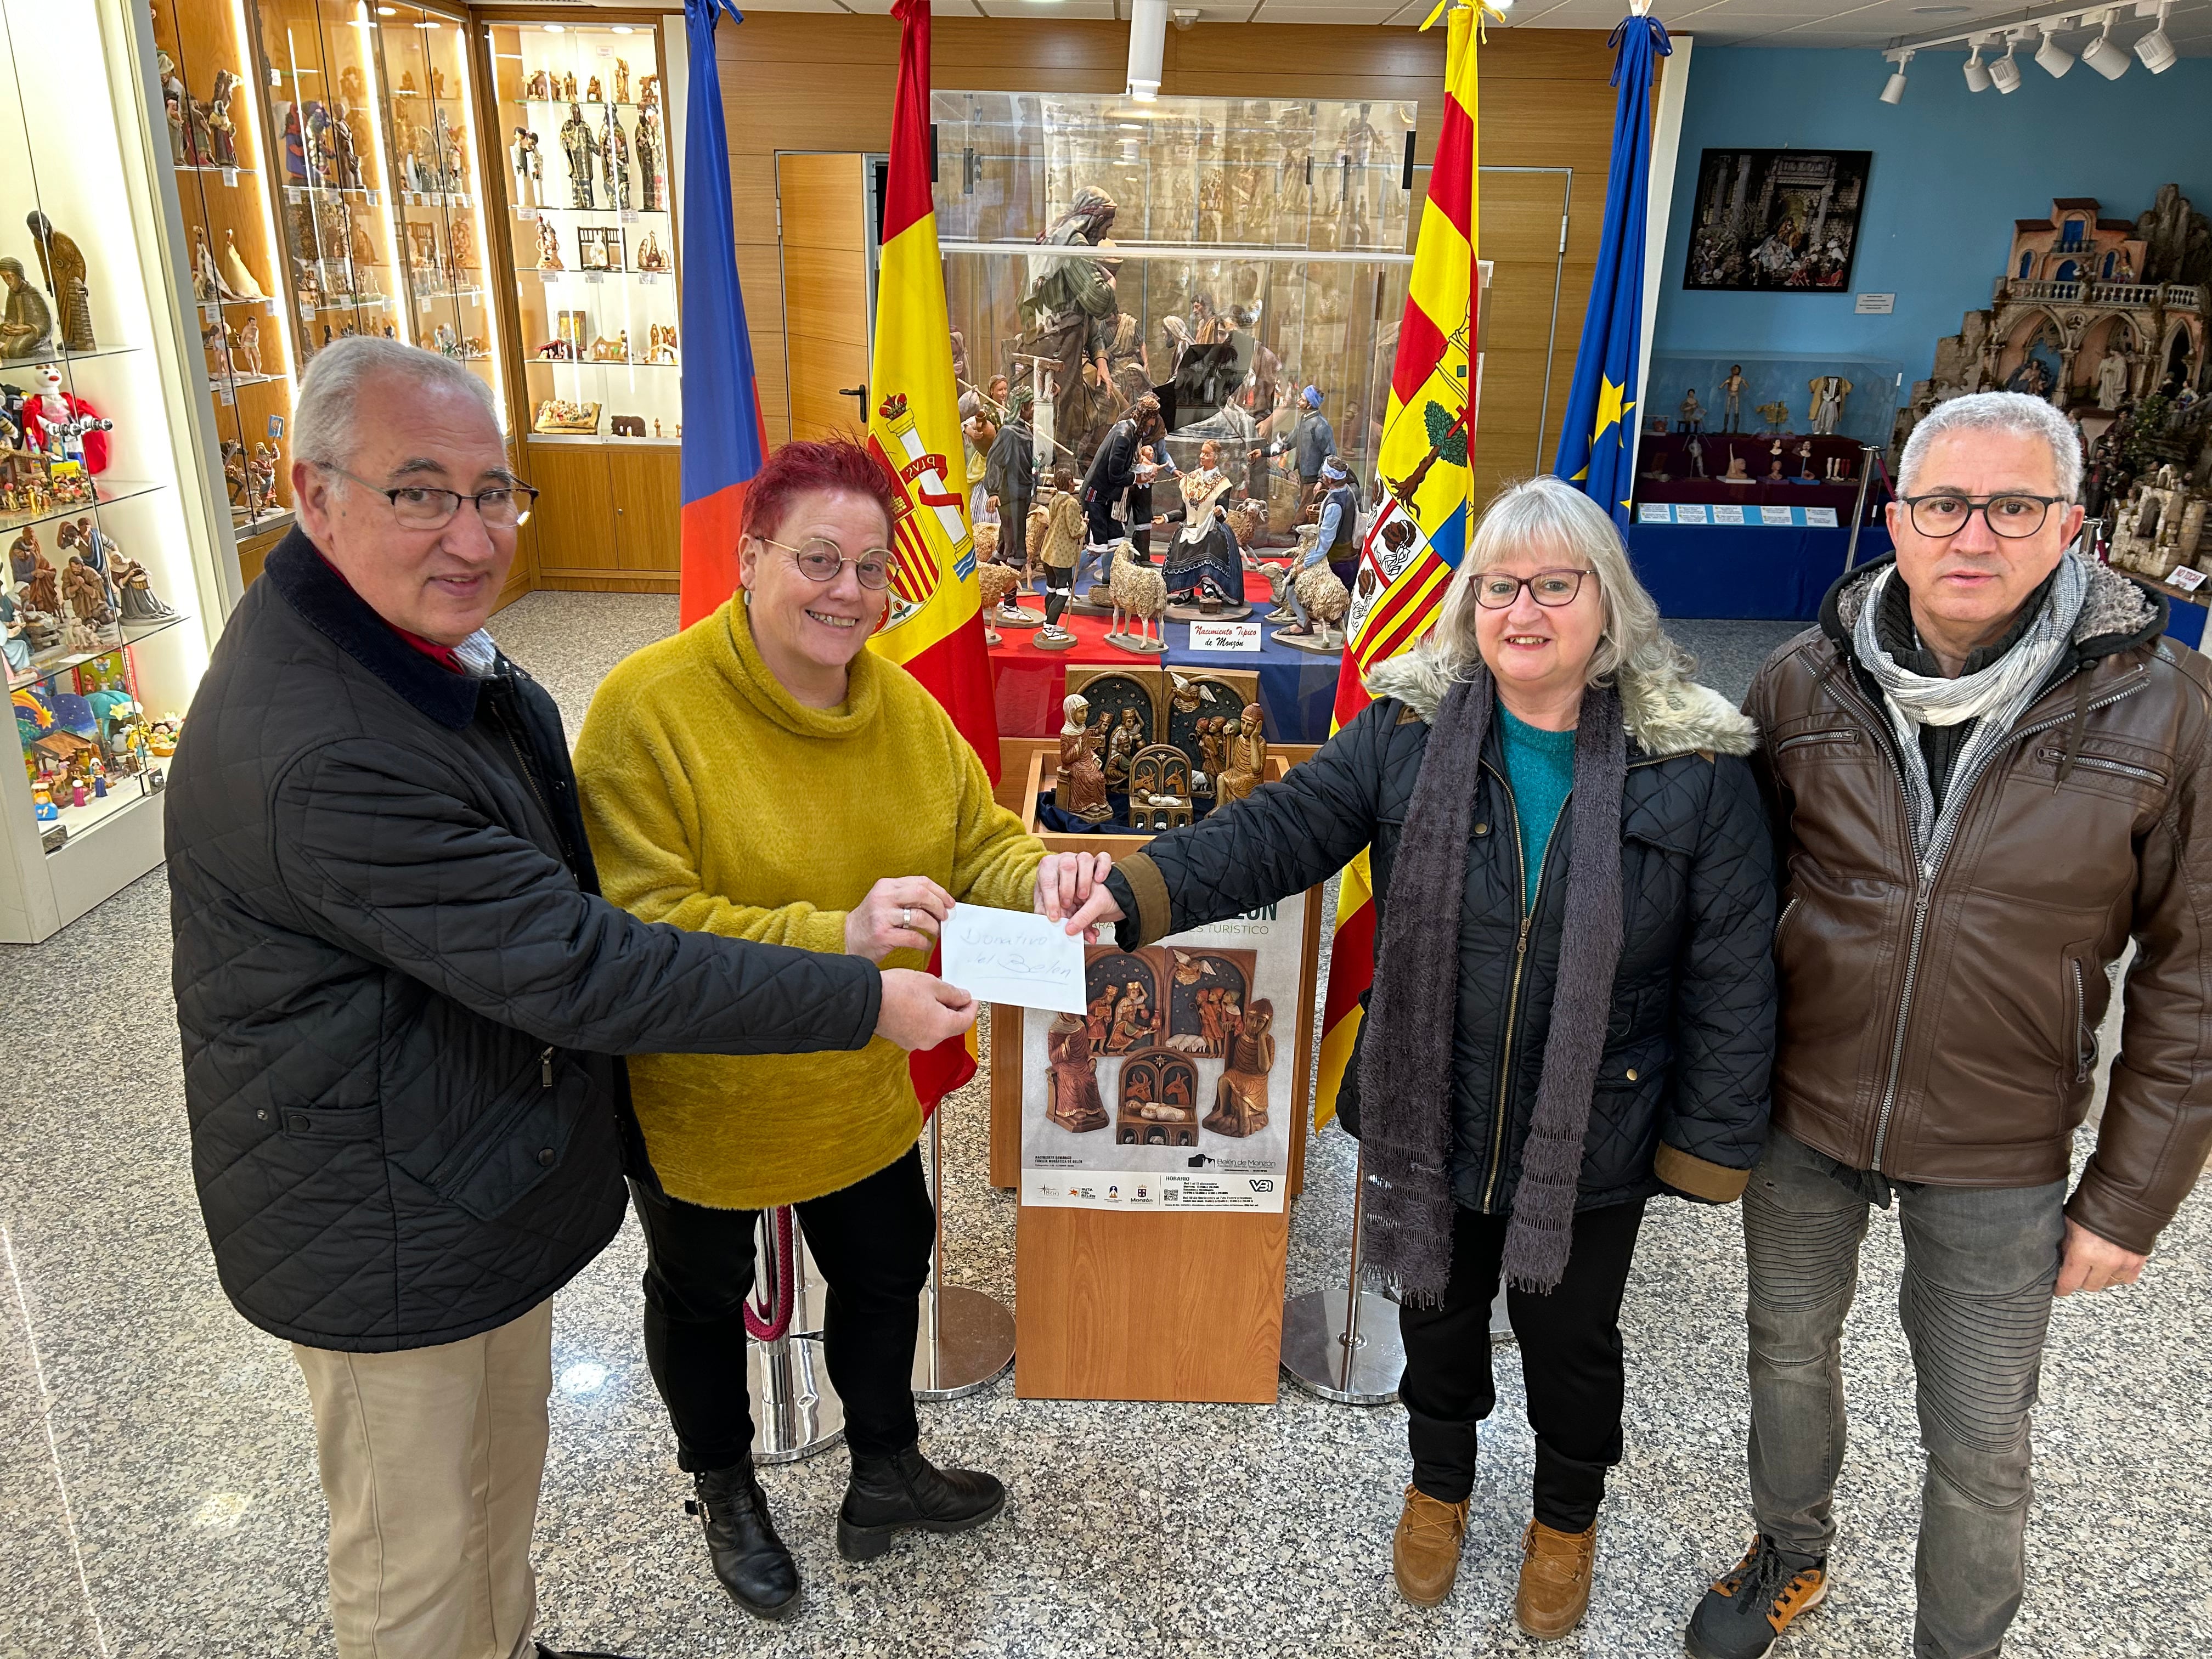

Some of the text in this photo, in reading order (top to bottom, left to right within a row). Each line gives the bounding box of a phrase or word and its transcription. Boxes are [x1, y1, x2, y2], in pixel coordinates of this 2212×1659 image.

[1194, 625, 1233, 636] Nacimiento
[1205, 637, 1244, 649] de Monzón
[1207, 922, 1269, 935] TURÍSTICO
[1217, 1158, 1237, 1166] Belén
